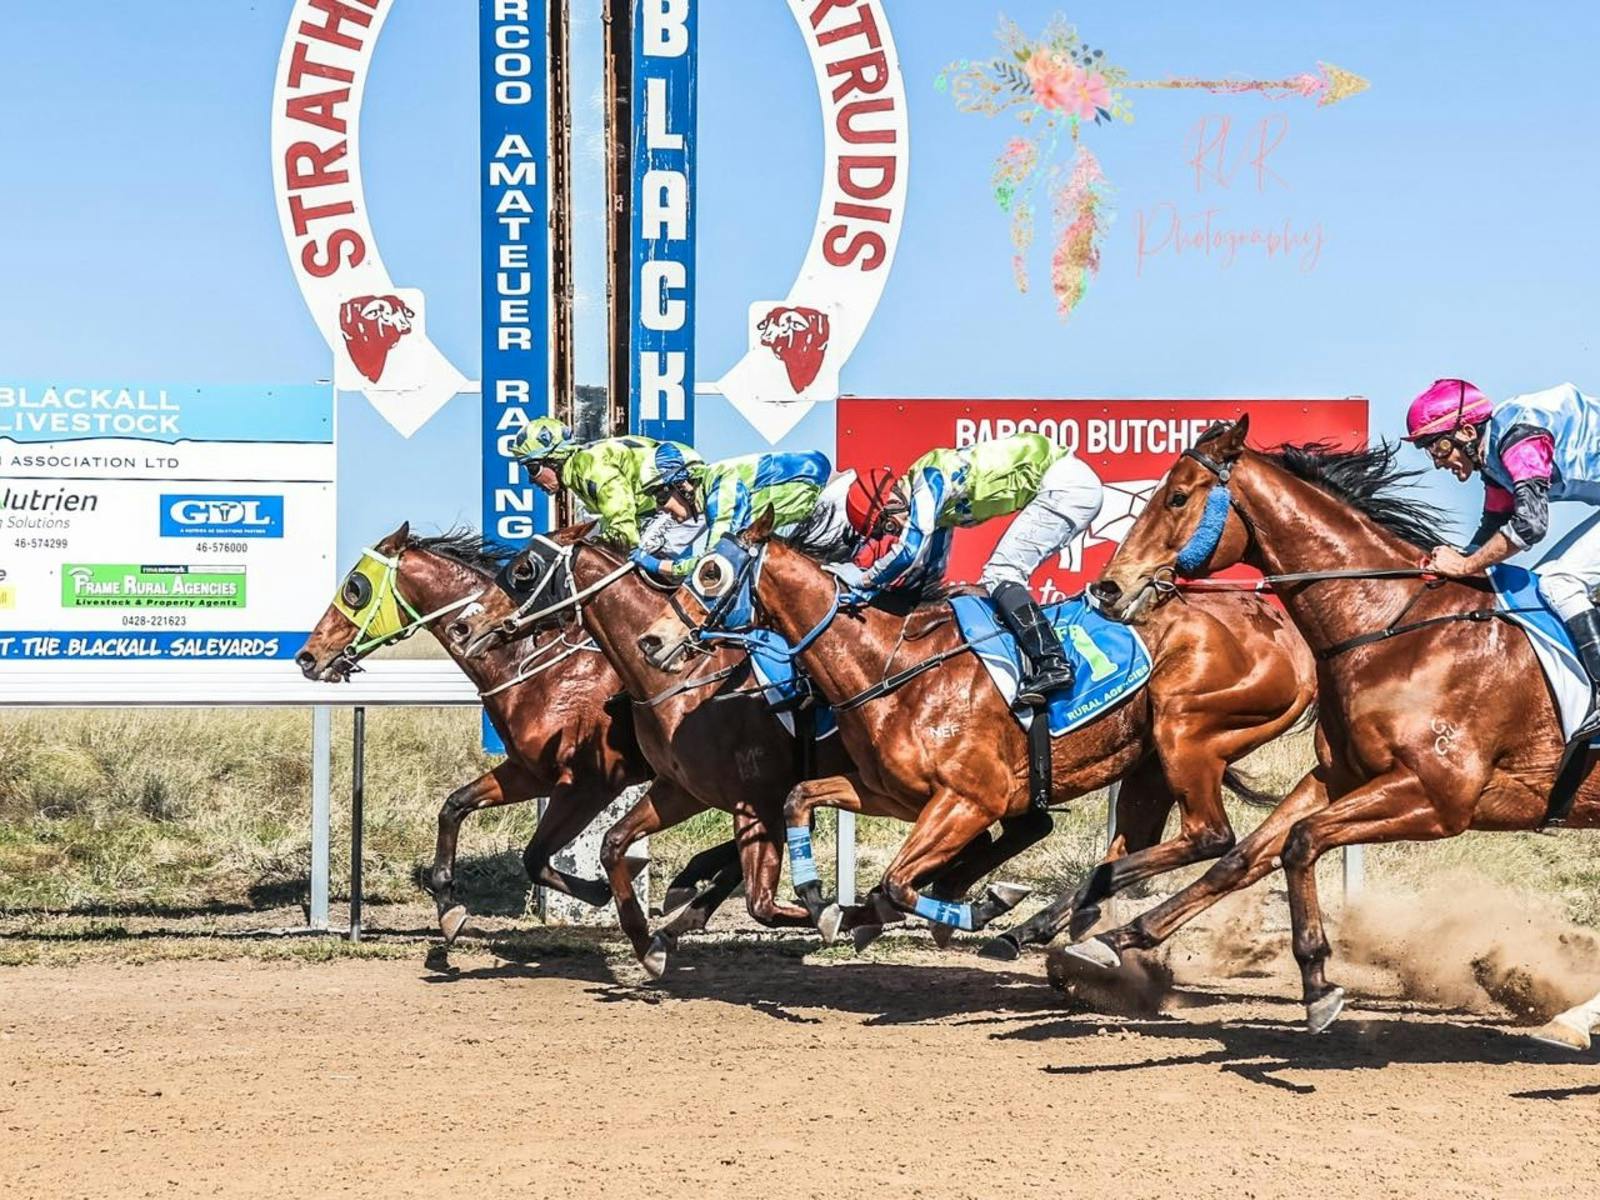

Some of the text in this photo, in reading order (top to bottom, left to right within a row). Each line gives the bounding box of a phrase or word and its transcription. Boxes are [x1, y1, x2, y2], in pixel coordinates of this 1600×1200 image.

[285, 0, 379, 278] STRATH
[640, 0, 689, 421] BLACK
[489, 134, 537, 350] AMATEUER
[11, 456, 136, 468] ASSOCIATION
[145, 458, 180, 469] LTD
[7, 515, 71, 529] Solutions
[14, 538, 68, 549] 46-574299
[195, 542, 249, 553] 46-576000
[124, 575, 168, 595] RURAL
[172, 575, 237, 596] AGENCIES
[146, 599, 195, 608] Property
[199, 599, 237, 608] Agents
[122, 615, 186, 626] 0428-221623
[1066, 698, 1103, 721] RURAL
